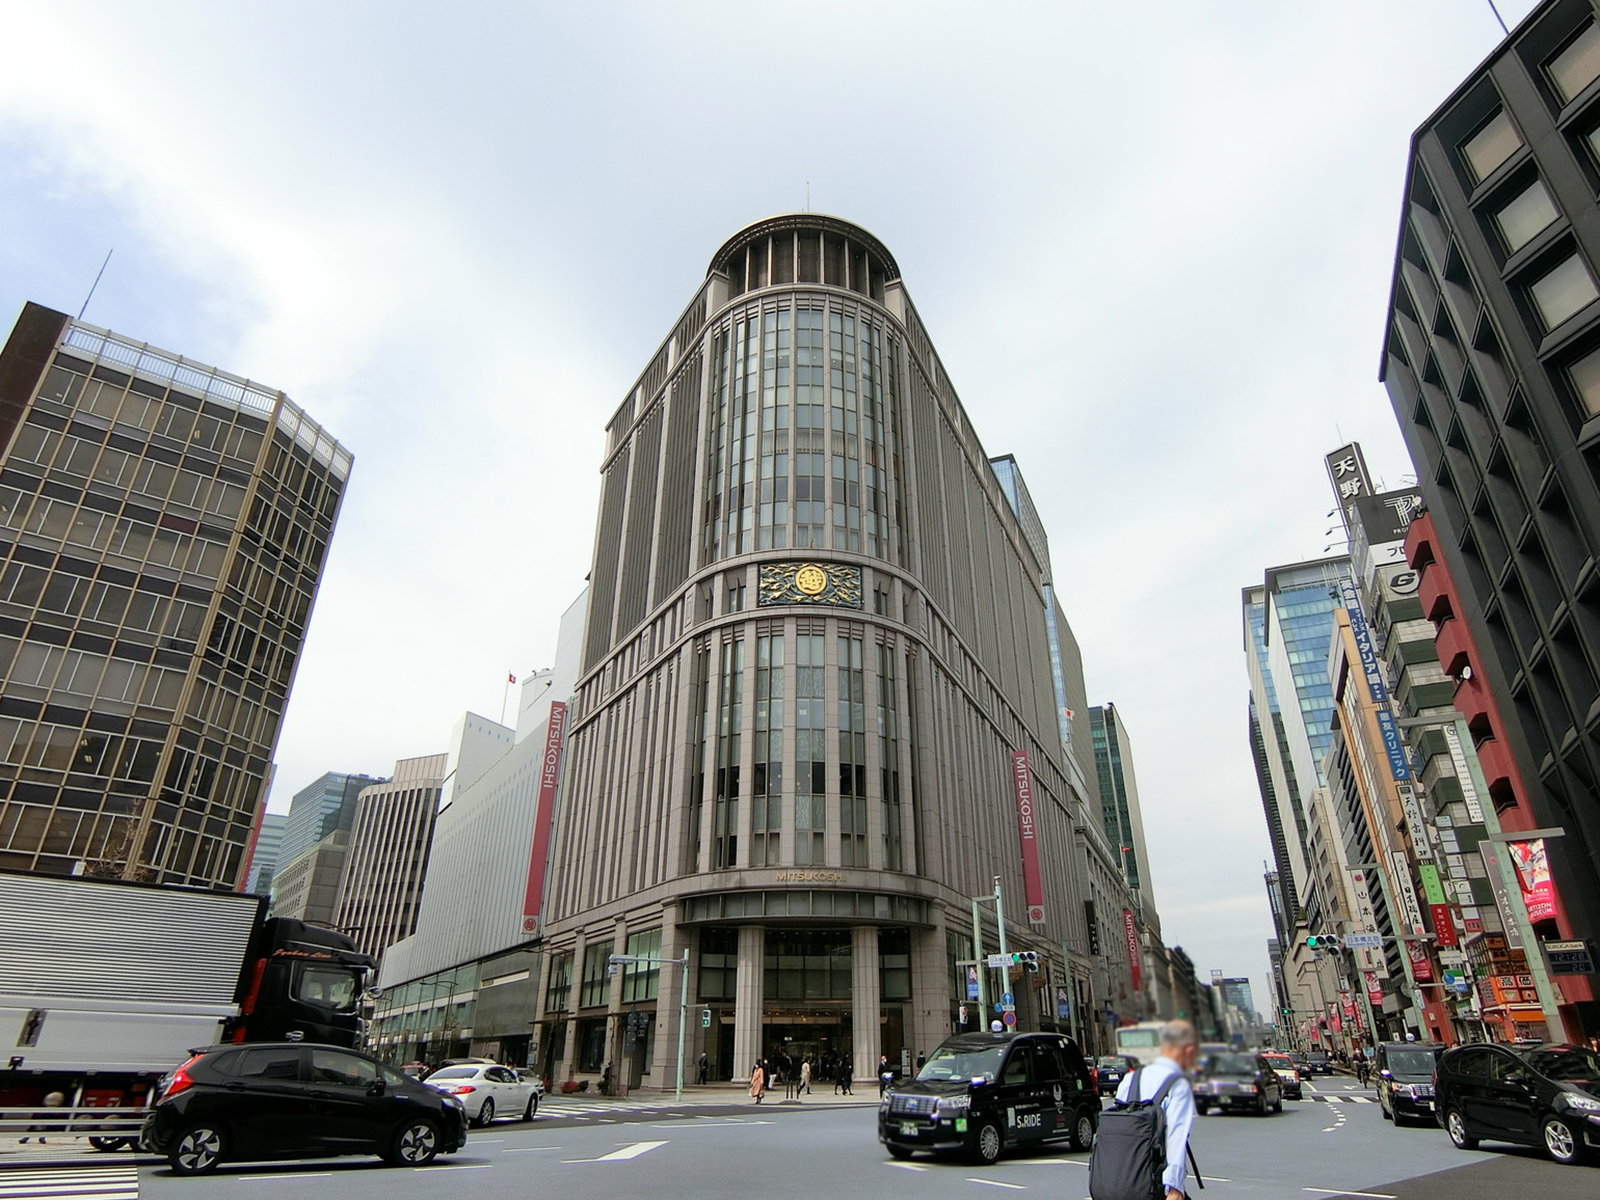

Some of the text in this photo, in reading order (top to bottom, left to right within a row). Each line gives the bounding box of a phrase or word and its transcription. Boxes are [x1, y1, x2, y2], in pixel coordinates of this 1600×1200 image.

[1333, 455, 1362, 519] 天野
[1357, 633, 1381, 685] イタリア語
[543, 707, 563, 789] MITSUKOSHI
[1016, 757, 1034, 840] MITSUKOSHI
[776, 872, 846, 882] MITSUKOSHI
[1555, 952, 1585, 961] 12:28
[1572, 963, 1585, 971] 20
